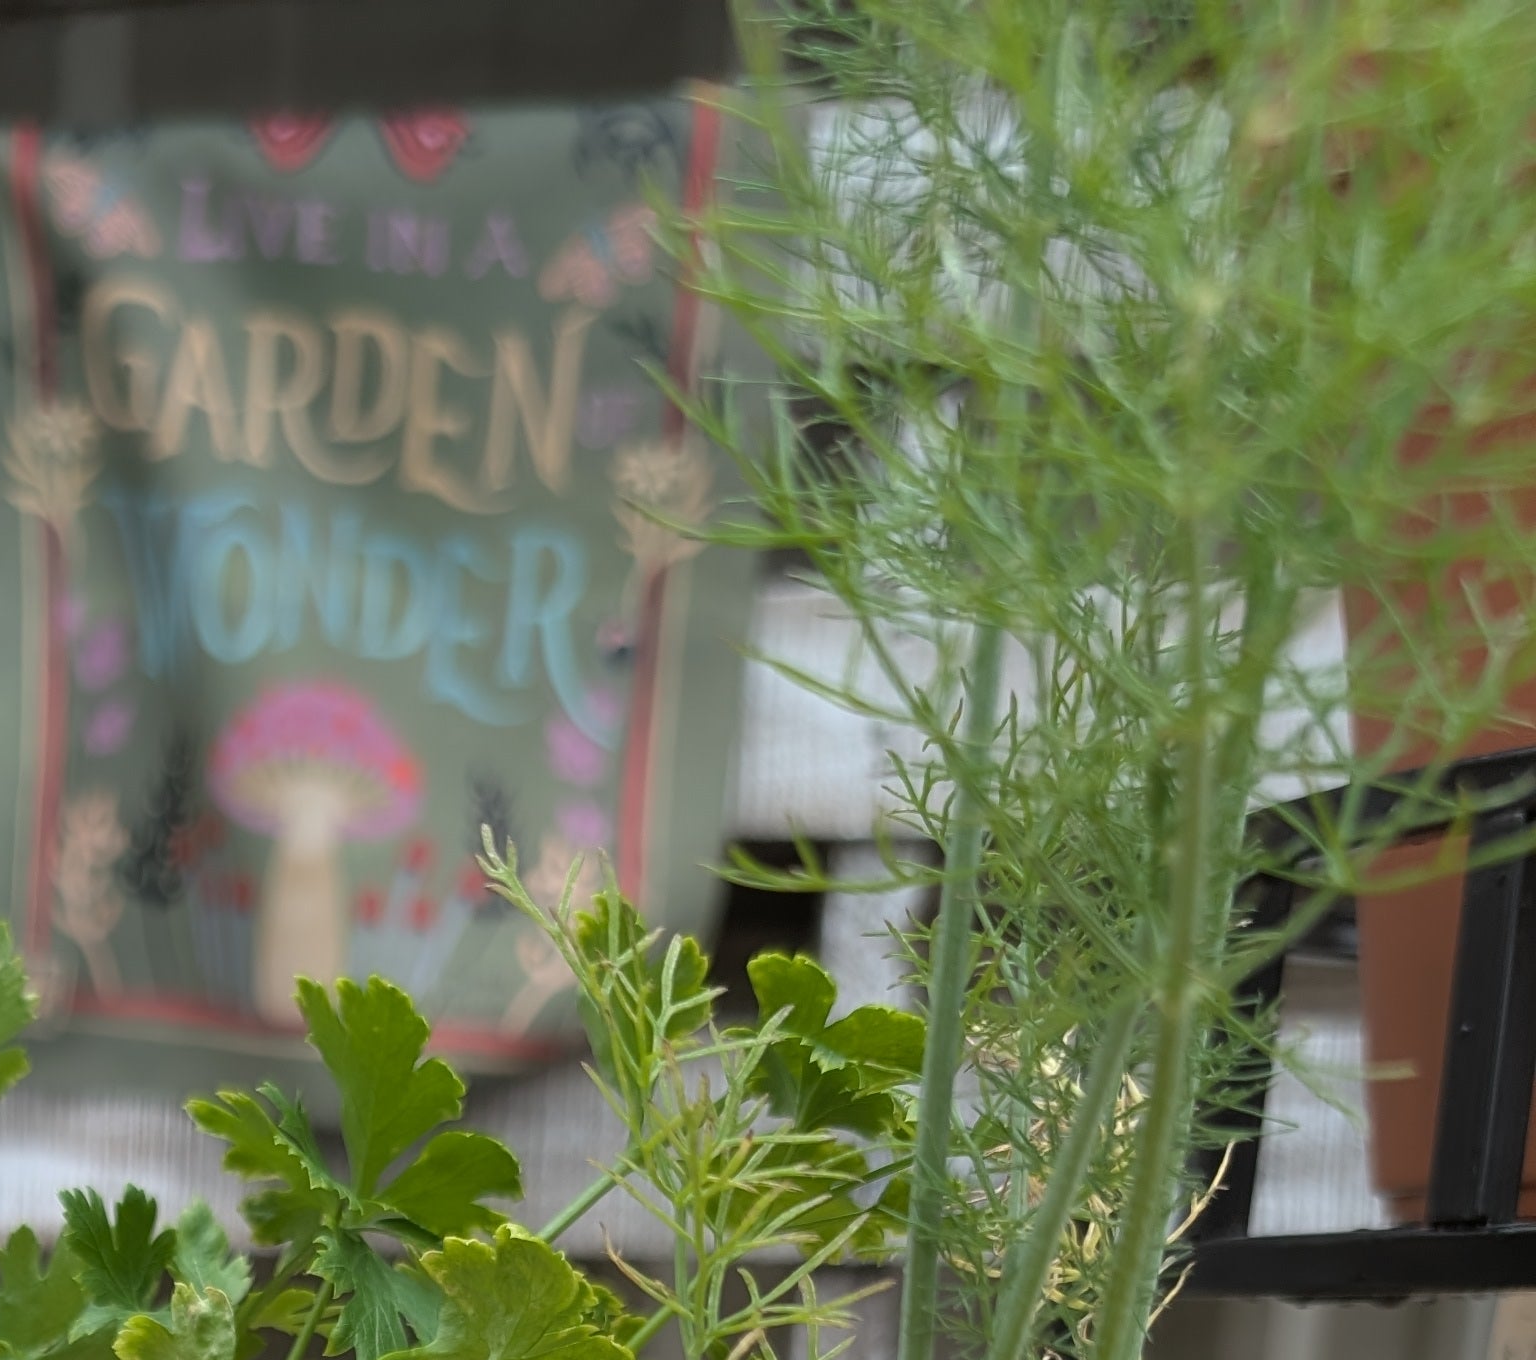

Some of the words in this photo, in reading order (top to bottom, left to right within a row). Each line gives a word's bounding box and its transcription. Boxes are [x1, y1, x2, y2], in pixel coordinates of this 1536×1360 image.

[368, 206, 454, 280] IN
[467, 208, 530, 282] A
[80, 278, 599, 515] GARDEN
